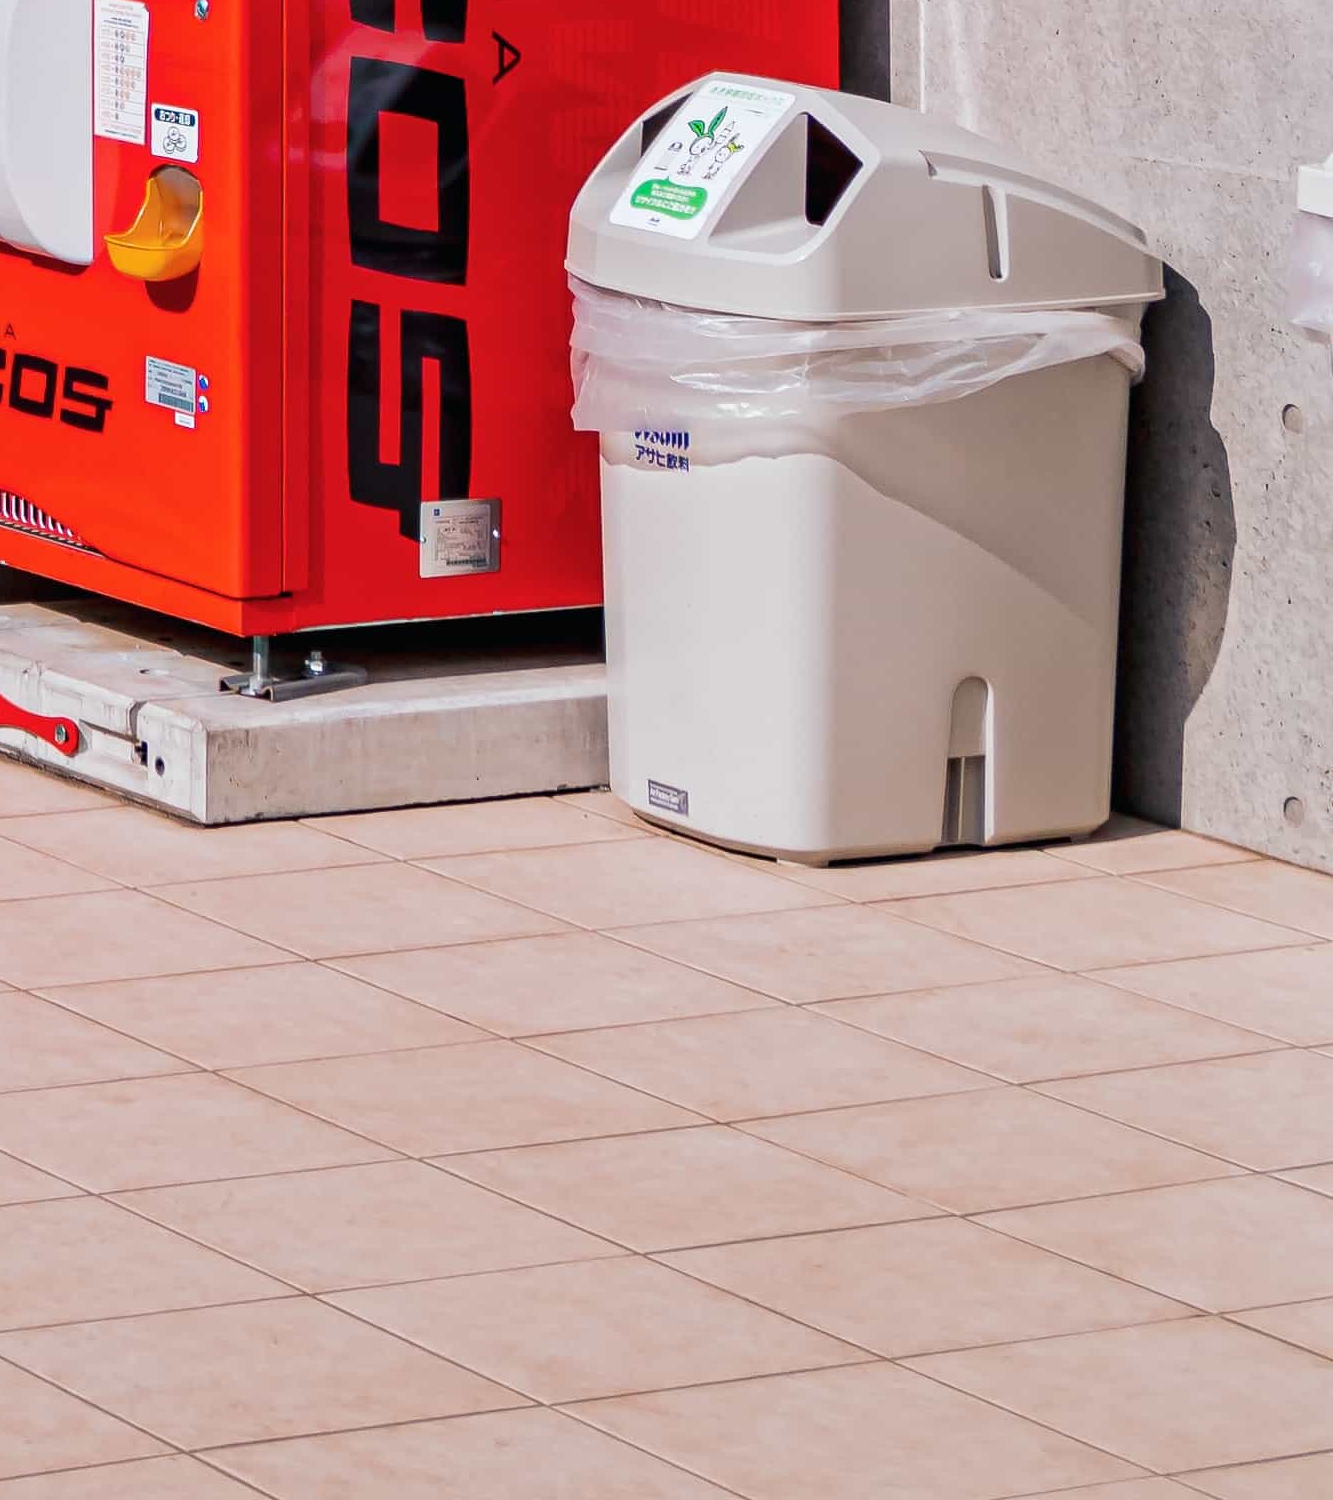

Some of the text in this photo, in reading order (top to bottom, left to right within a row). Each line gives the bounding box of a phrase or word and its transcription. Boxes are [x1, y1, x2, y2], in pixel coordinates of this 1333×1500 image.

[635, 444, 689, 473] アサヒ飲料
